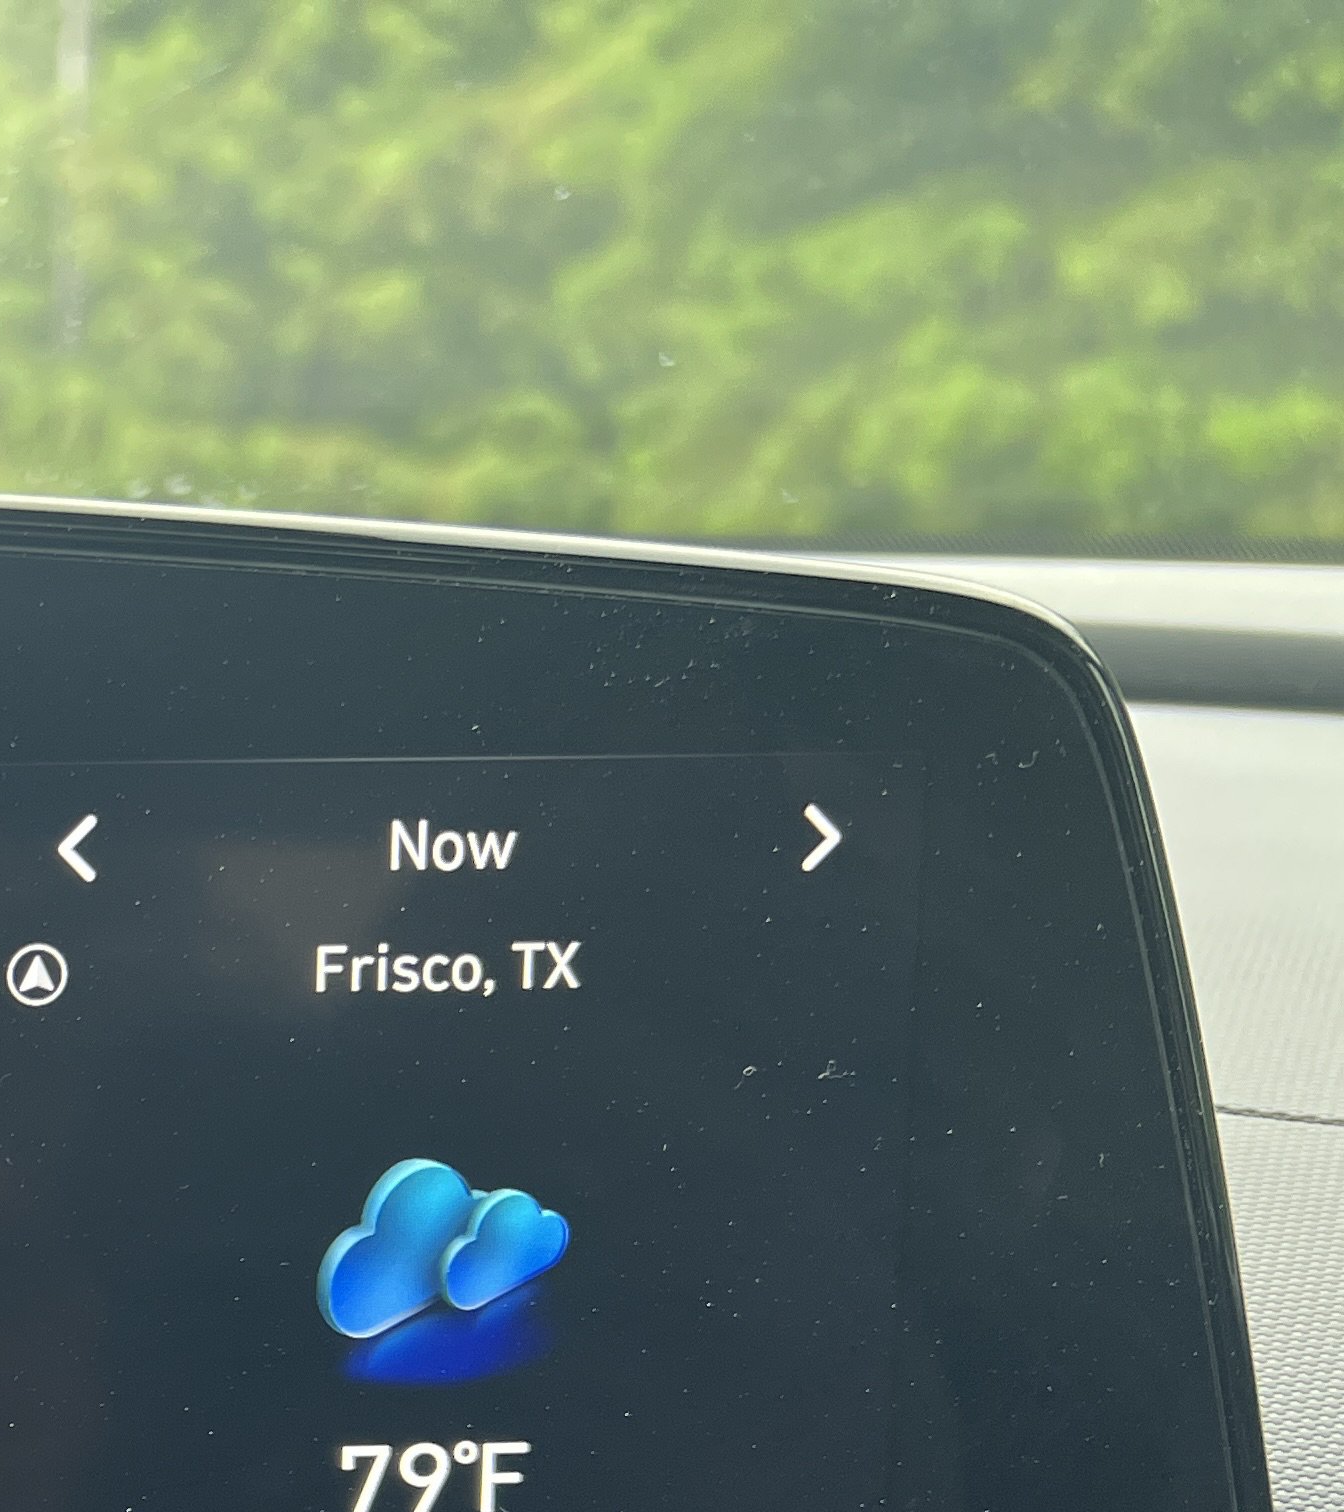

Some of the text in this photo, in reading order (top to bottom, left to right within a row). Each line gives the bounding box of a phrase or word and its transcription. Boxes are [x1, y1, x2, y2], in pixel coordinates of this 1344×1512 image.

[388, 819, 518, 873] Now
[314, 941, 583, 998] Frisco, TX
